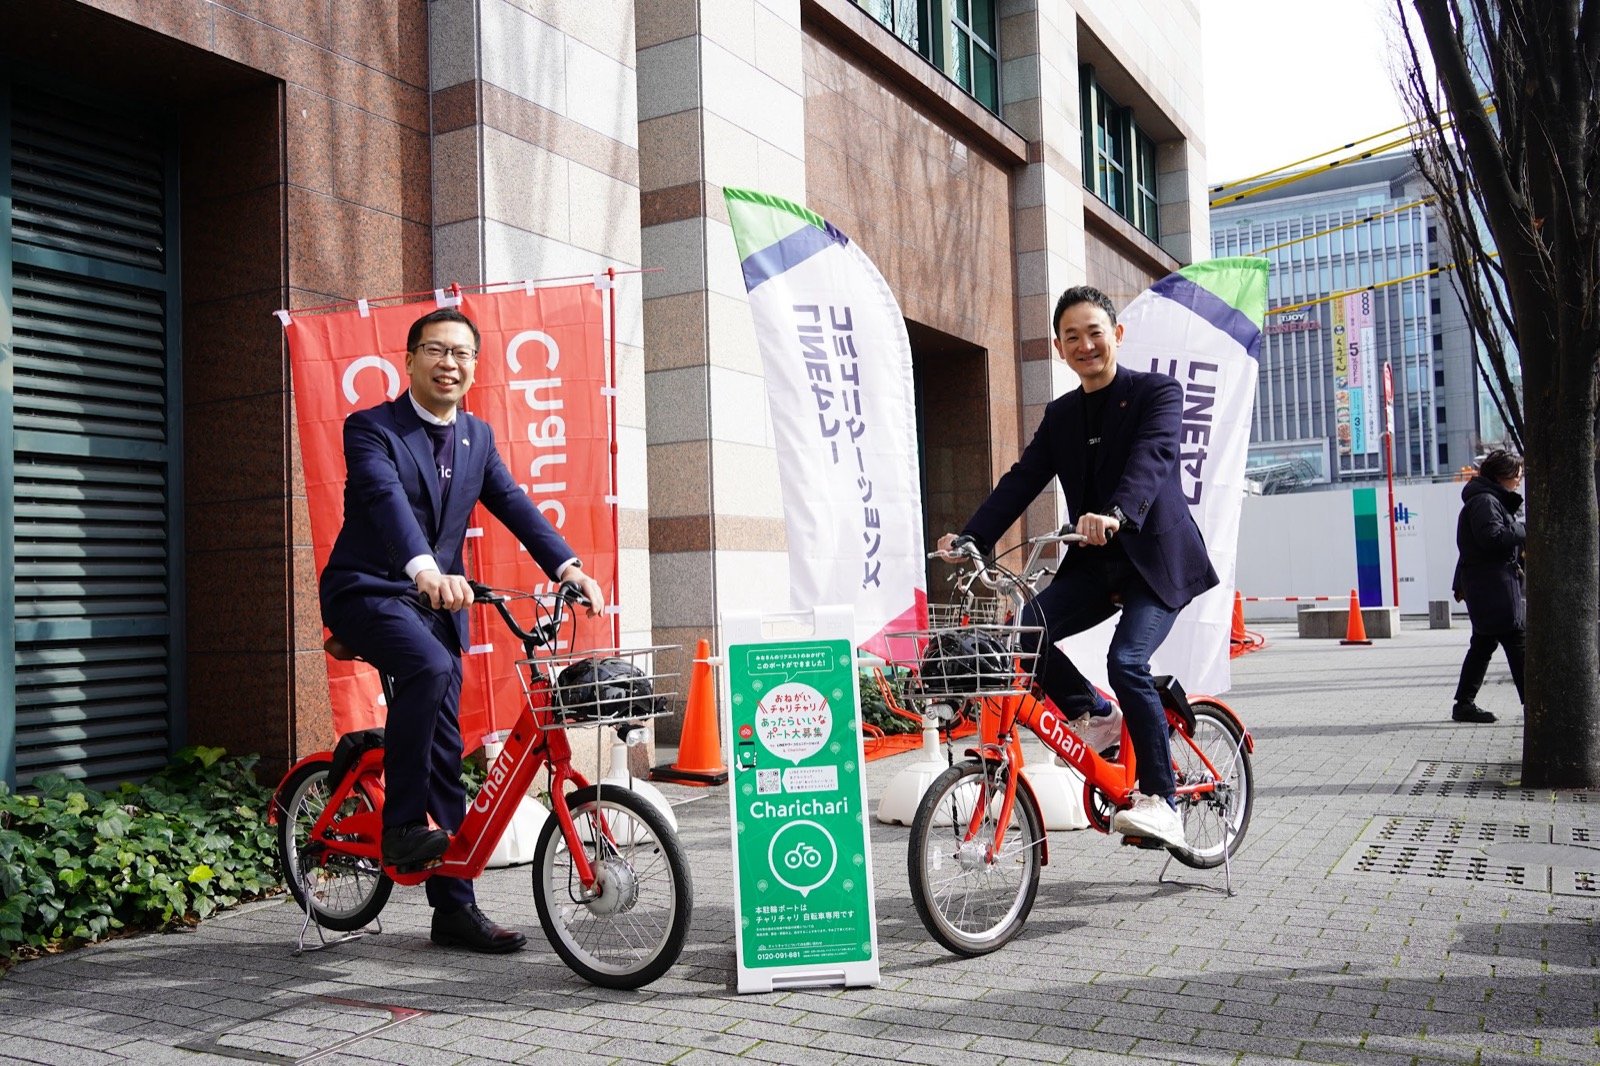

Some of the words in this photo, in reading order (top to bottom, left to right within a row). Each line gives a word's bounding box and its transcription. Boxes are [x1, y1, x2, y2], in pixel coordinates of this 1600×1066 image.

[775, 692, 811, 703] おねがい
[770, 703, 816, 714] チャリチャリ
[761, 715, 826, 727] あったらいいな
[766, 727, 823, 740] ポート大募集
[1039, 710, 1087, 763] Chari
[473, 749, 514, 814] Chari
[750, 797, 848, 819] Charichari
[755, 904, 807, 914] 本駐輪ポートは
[755, 914, 799, 924] チャリチャリ
[803, 911, 855, 921] 自転車専用です
